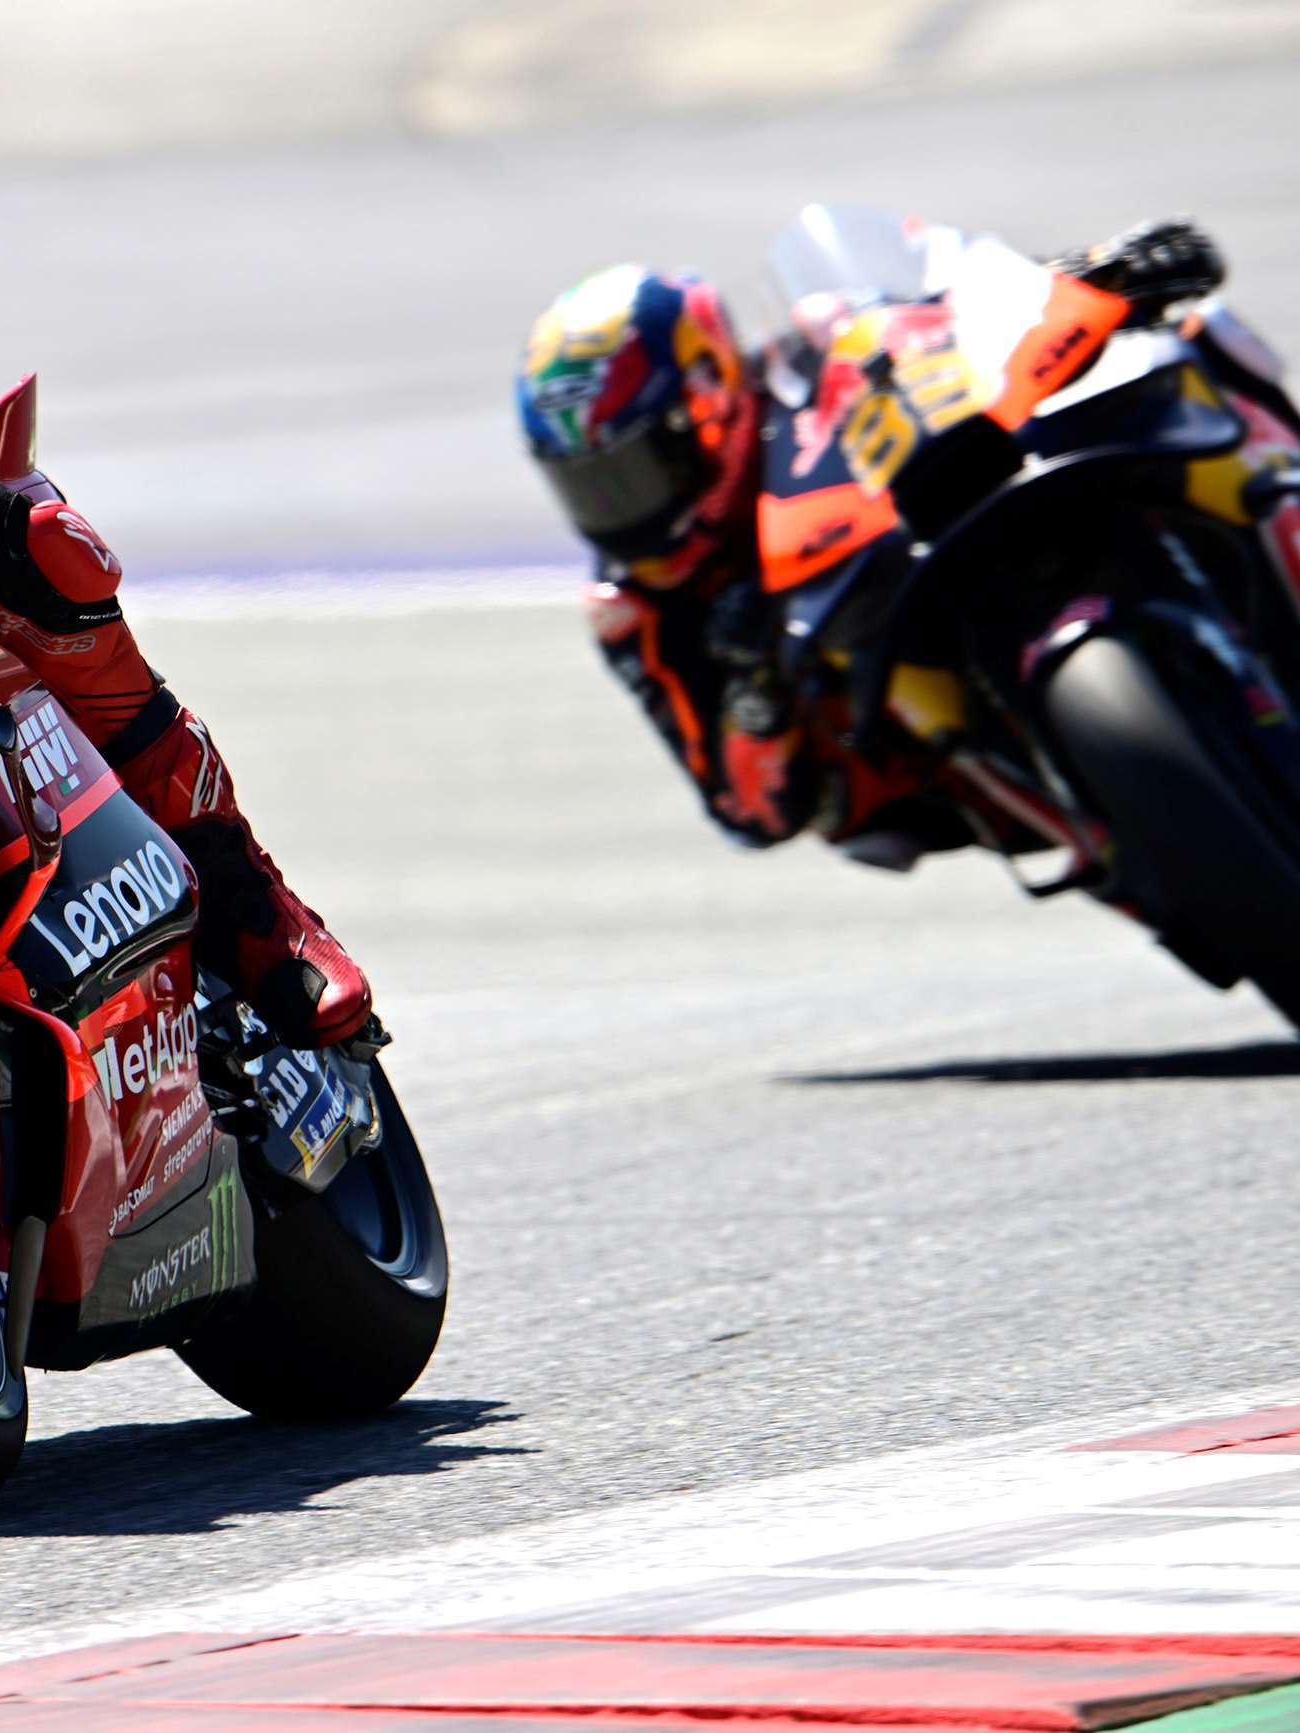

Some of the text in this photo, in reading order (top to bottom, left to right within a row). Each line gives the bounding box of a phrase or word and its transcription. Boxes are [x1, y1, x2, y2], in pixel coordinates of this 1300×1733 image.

[30, 840, 180, 978] Lenovo
[92, 1002, 198, 1111] NetApp
[130, 1226, 211, 1309] MONSTER
